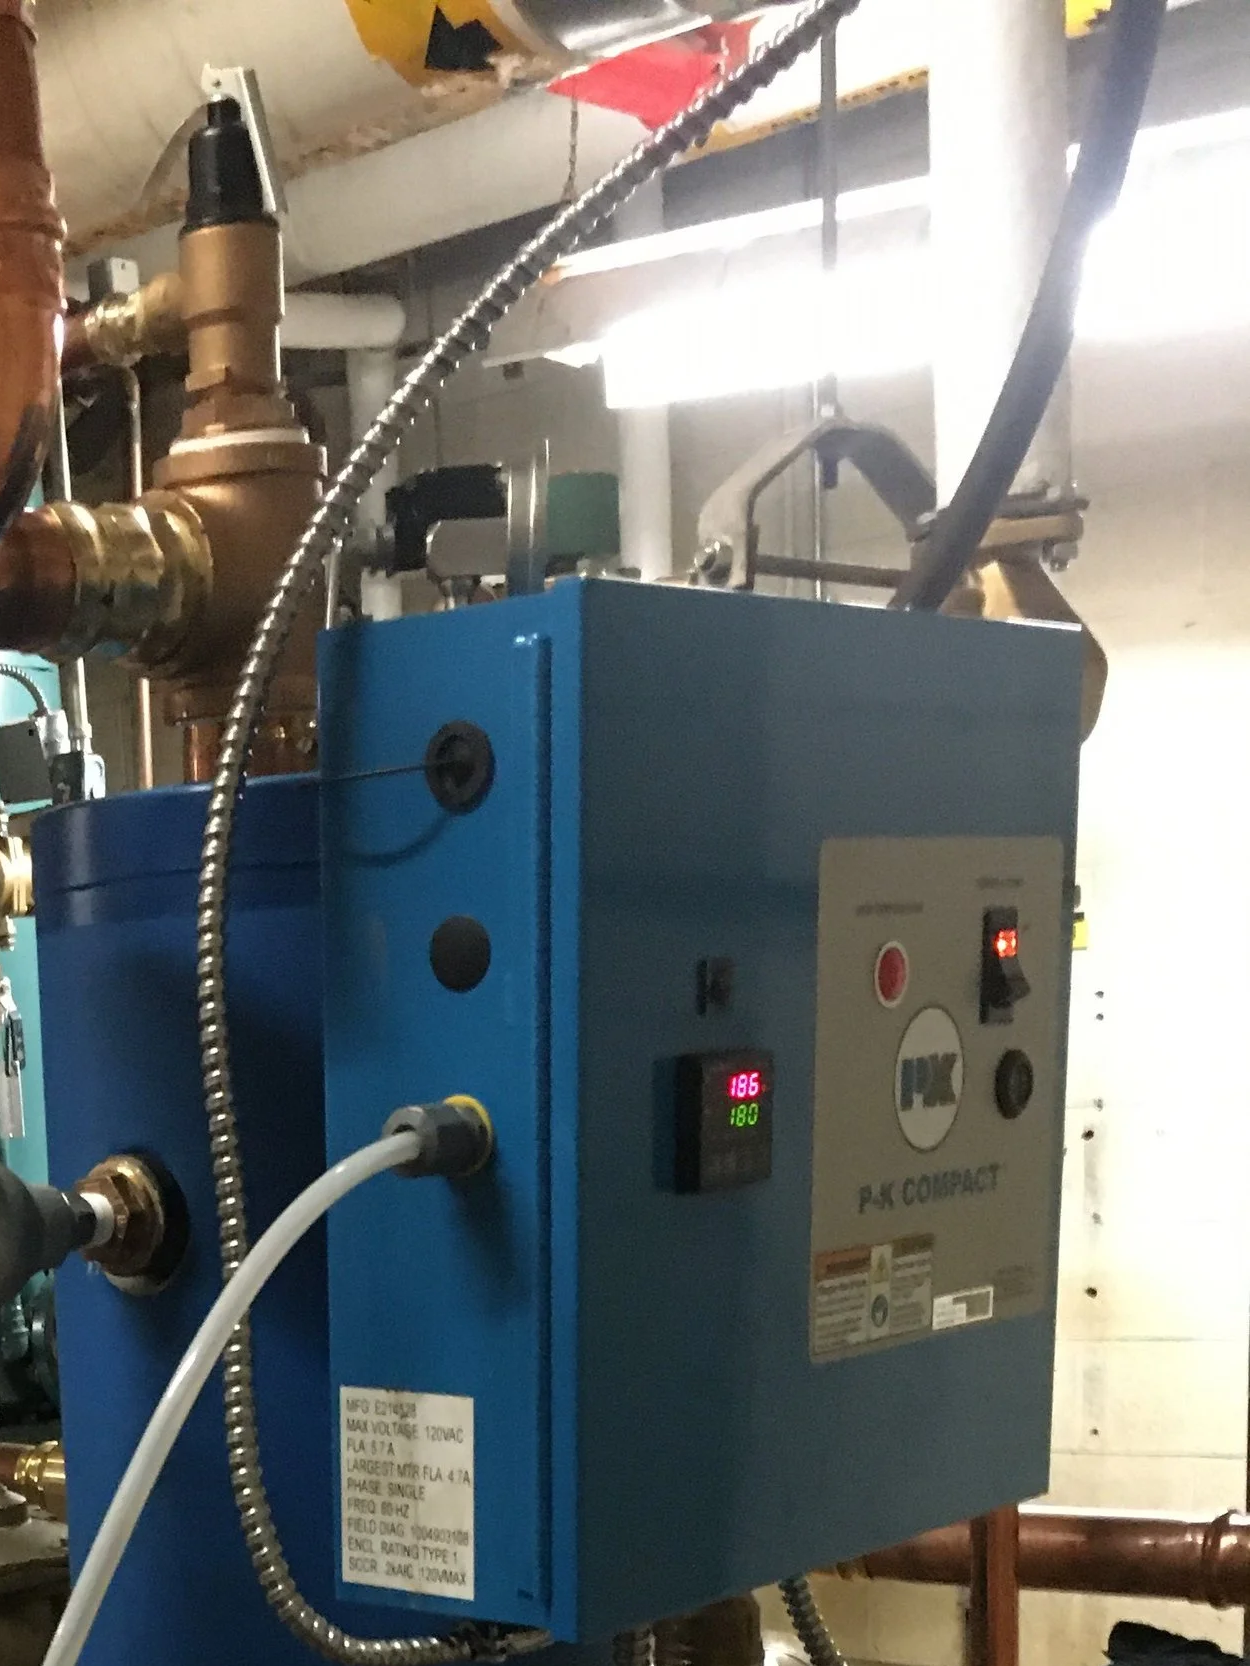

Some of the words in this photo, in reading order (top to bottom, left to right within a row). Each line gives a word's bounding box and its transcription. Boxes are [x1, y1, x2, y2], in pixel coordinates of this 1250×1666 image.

[731, 1072, 760, 1098] 186
[730, 1103, 759, 1127] 180
[858, 1183, 897, 1215] P-K
[902, 1165, 1001, 1207] COMPACT
[346, 1419, 367, 1433] MAX
[372, 1421, 418, 1440] VOLTAGE
[426, 1425, 464, 1443] 120VAC
[347, 1438, 365, 1452] FLA
[347, 1459, 394, 1477] LARGEST
[397, 1462, 420, 1480] MTR
[423, 1465, 442, 1482] FLA
[347, 1477, 381, 1495] PHASE
[388, 1482, 425, 1501] SINGLE
[396, 1504, 409, 1519] HZ
[347, 1518, 376, 1534] FIELD
[380, 1522, 404, 1538] DIAG
[381, 1541, 419, 1560] RATING
[422, 1546, 448, 1563] TYPE
[453, 1550, 457, 1564] 1
[349, 1557, 377, 1573] SCCR
